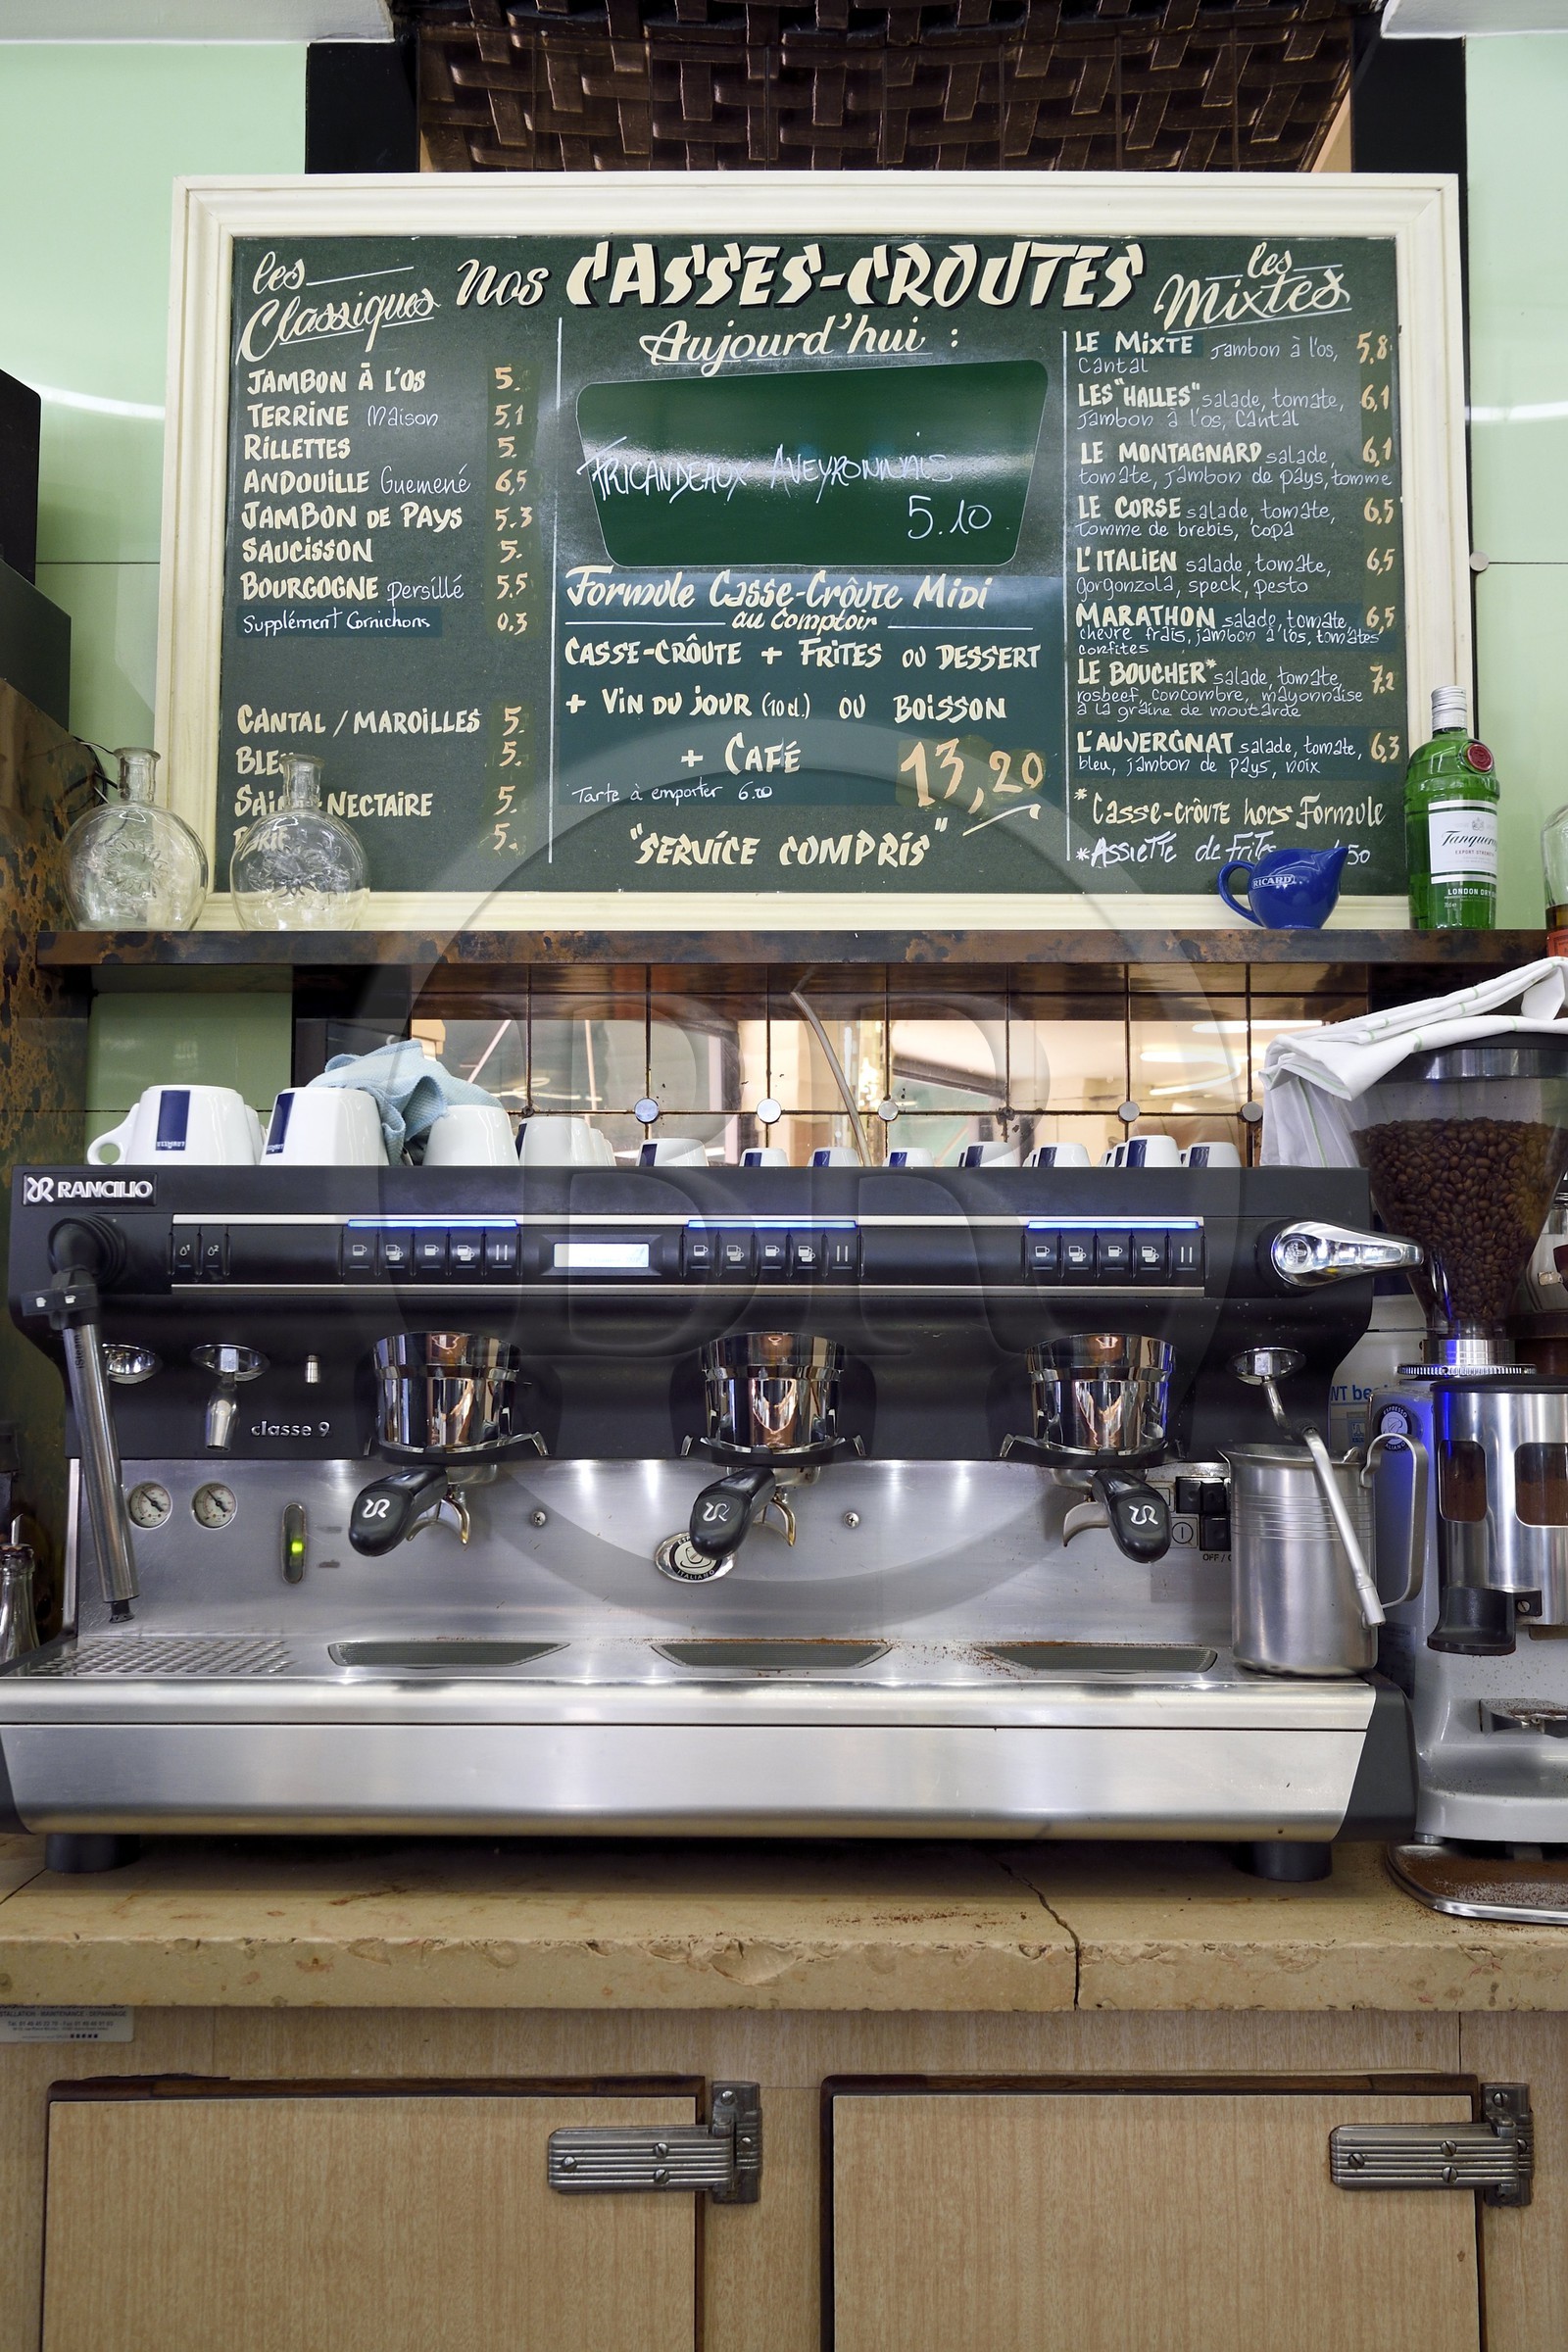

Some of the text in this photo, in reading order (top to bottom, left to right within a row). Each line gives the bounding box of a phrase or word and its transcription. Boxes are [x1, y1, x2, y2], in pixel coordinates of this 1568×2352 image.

[253, 251, 305, 294] les
[1247, 241, 1293, 279] les
[457, 241, 1144, 308] Nos CASSES-CROUTES
[1153, 268, 1350, 331] Mixtes
[235, 288, 441, 366] Classiques
[639, 313, 925, 376] Aujourd'hui
[1075, 330, 1101, 354] LE
[1290, 335, 1301, 359] à
[247, 368, 346, 395] JAMBON
[385, 367, 425, 392] L'OS
[1078, 383, 1113, 408] LES
[1201, 389, 1266, 412] salade,
[1272, 388, 1345, 412] tomate,
[368, 406, 438, 426] Maison
[1167, 407, 1179, 428] à
[1080, 442, 1103, 465] LE
[1118, 441, 1262, 465] MONTAGNARD
[1079, 466, 1157, 489] tomate,
[1251, 467, 1273, 485] de
[241, 502, 463, 532] JAMBON DE PAYS
[1079, 495, 1101, 520] LE
[1114, 496, 1182, 519] CORSE
[1260, 498, 1336, 524] tomate,
[1149, 519, 1169, 537] de
[1178, 521, 1239, 541] brebis,
[1254, 553, 1331, 577] tomate,
[240, 570, 465, 609] BOURGOGNE persillé
[565, 564, 696, 608] Formule
[1188, 574, 1249, 600] speck,
[1253, 575, 1308, 600] pesto
[244, 608, 431, 636] Supplément Cornichons
[732, 610, 765, 629] au
[1076, 603, 1216, 628] MARATHON
[935, 644, 1042, 672] DESSERT
[1078, 640, 1150, 655] confites
[1078, 659, 1101, 685] LE
[652, 692, 683, 715] DU
[1152, 687, 1250, 704] concombre,
[1261, 688, 1364, 707] mayonnaise
[237, 705, 326, 734] CANTAL
[1096, 703, 1110, 716] la
[1117, 702, 1172, 722] graine
[1180, 702, 1202, 716] de
[1210, 702, 1301, 717] moutarde
[725, 731, 801, 775] CAFÉ
[1077, 729, 1234, 754] L'AUVERGNAT
[1303, 735, 1362, 760] tomate,
[901, 737, 1045, 815] 13,20
[1078, 755, 1115, 775] bleu,
[1126, 755, 1190, 775] jambon
[1200, 758, 1217, 773] de
[1286, 760, 1321, 774] noix
[572, 776, 723, 807] Tarte à emporter
[1244, 793, 1387, 830] hors Formule
[1195, 834, 1221, 861] de
[1252, 874, 1293, 888] RICARD
[57, 1180, 154, 1200] RANCILIO
[251, 1420, 330, 1438] classe 9
[1202, 1553, 1220, 1562] OFF
[676, 1569, 715, 1580] ITALIANO
